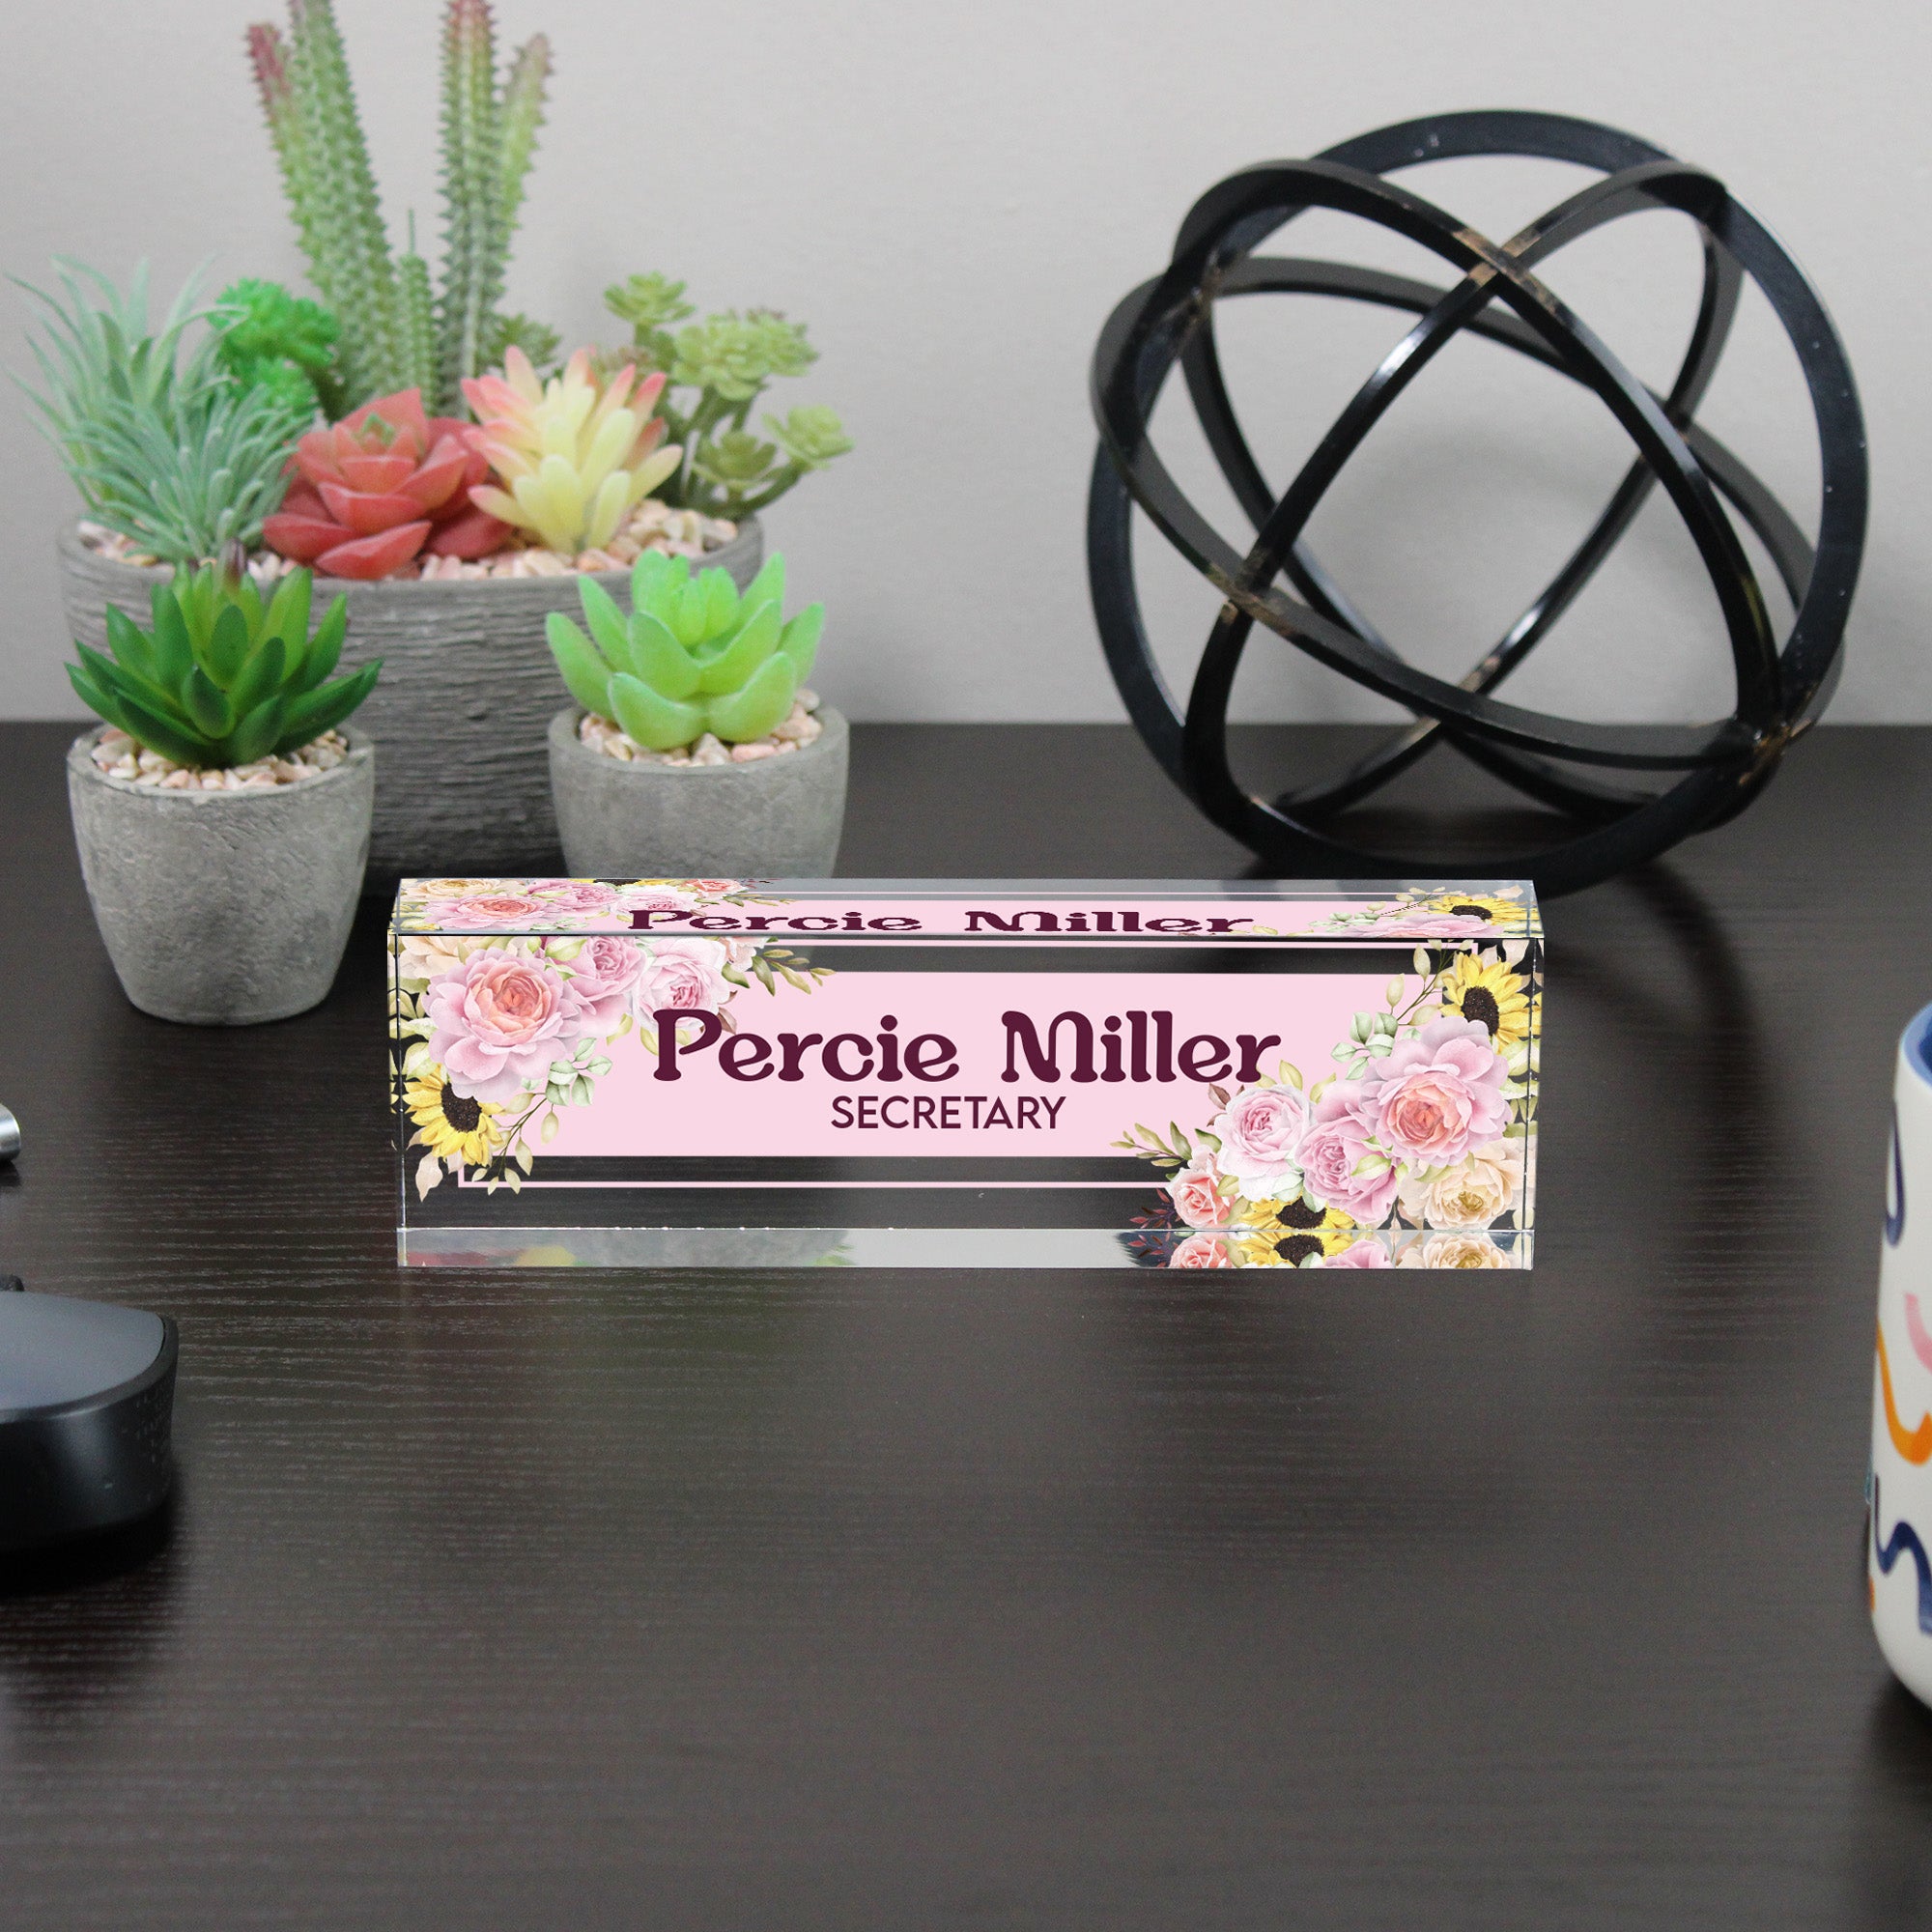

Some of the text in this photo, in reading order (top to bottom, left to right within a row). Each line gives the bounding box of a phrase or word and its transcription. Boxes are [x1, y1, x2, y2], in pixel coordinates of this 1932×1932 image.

[628, 910, 1254, 933] Percie Miller
[653, 1009, 1282, 1083] Percie Miller
[831, 1095, 1066, 1129] SECRETARY
